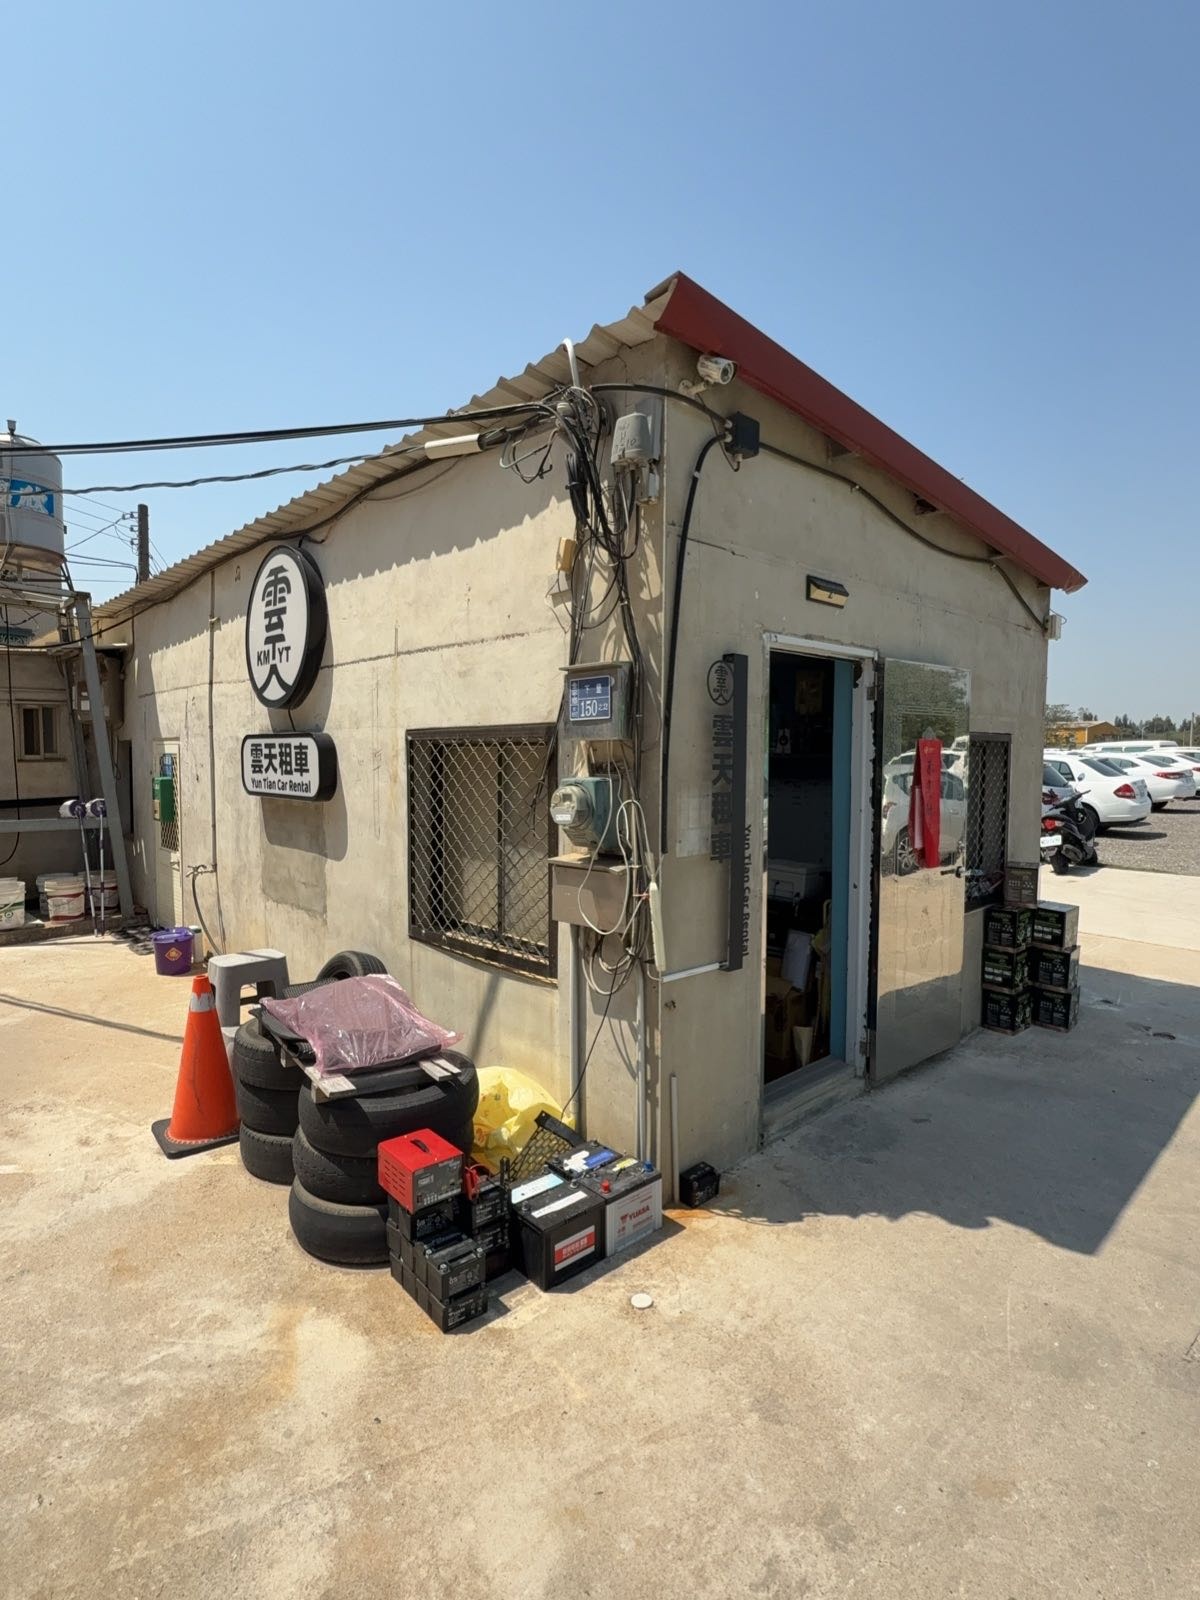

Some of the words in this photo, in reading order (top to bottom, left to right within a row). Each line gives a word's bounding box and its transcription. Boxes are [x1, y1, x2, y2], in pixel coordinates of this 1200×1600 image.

[580, 700, 597, 717] 150
[250, 742, 310, 777] 雲天租車
[251, 777, 262, 789] Yun
[262, 777, 276, 790] Tian
[277, 779, 288, 791] Car
[289, 780, 311, 793] Rental
